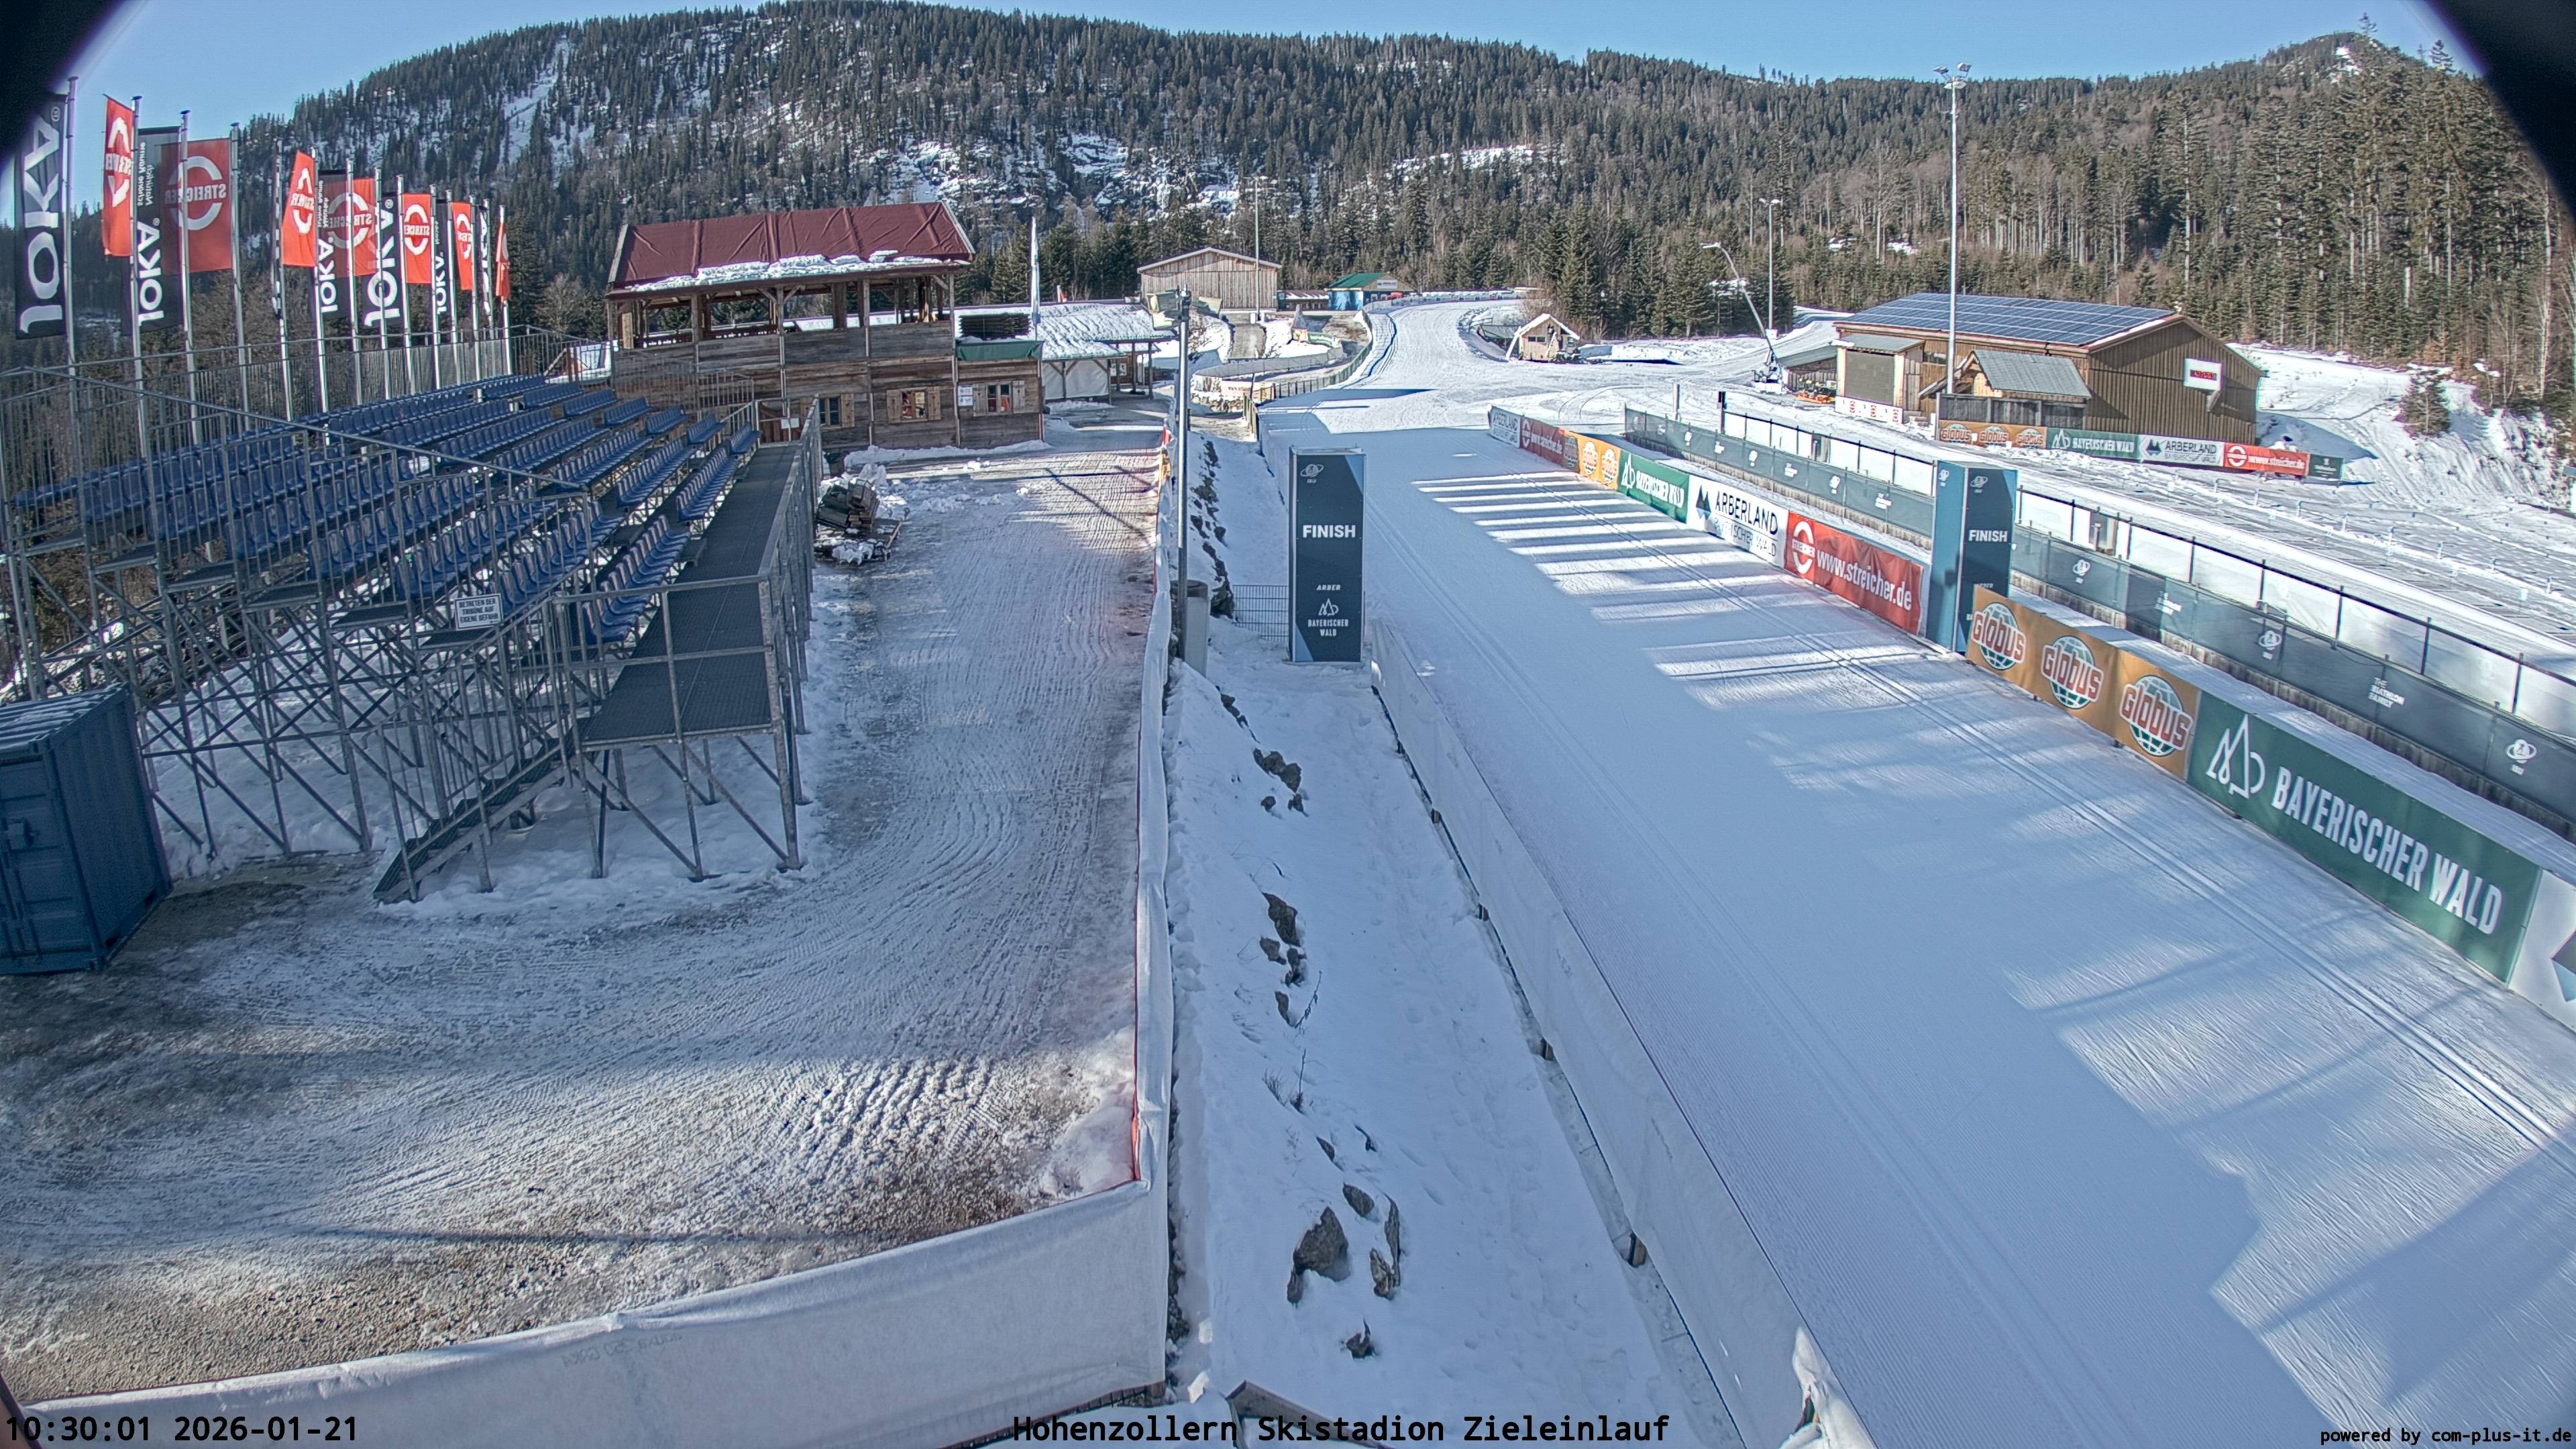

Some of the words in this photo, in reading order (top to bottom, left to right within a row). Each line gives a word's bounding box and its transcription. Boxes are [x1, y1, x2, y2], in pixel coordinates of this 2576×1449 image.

[1715, 491, 1778, 535] ARBERLAND
[1302, 525, 1356, 538] FINISH
[1968, 529, 2008, 543] FINISH
[1817, 549, 1912, 611] www.streicher.de
[1307, 619, 1349, 627] BAYERISCHER
[1320, 628, 1337, 637] WALD
[2271, 765, 2429, 892] BAYERISCHER
[2428, 853, 2503, 935] WALD
